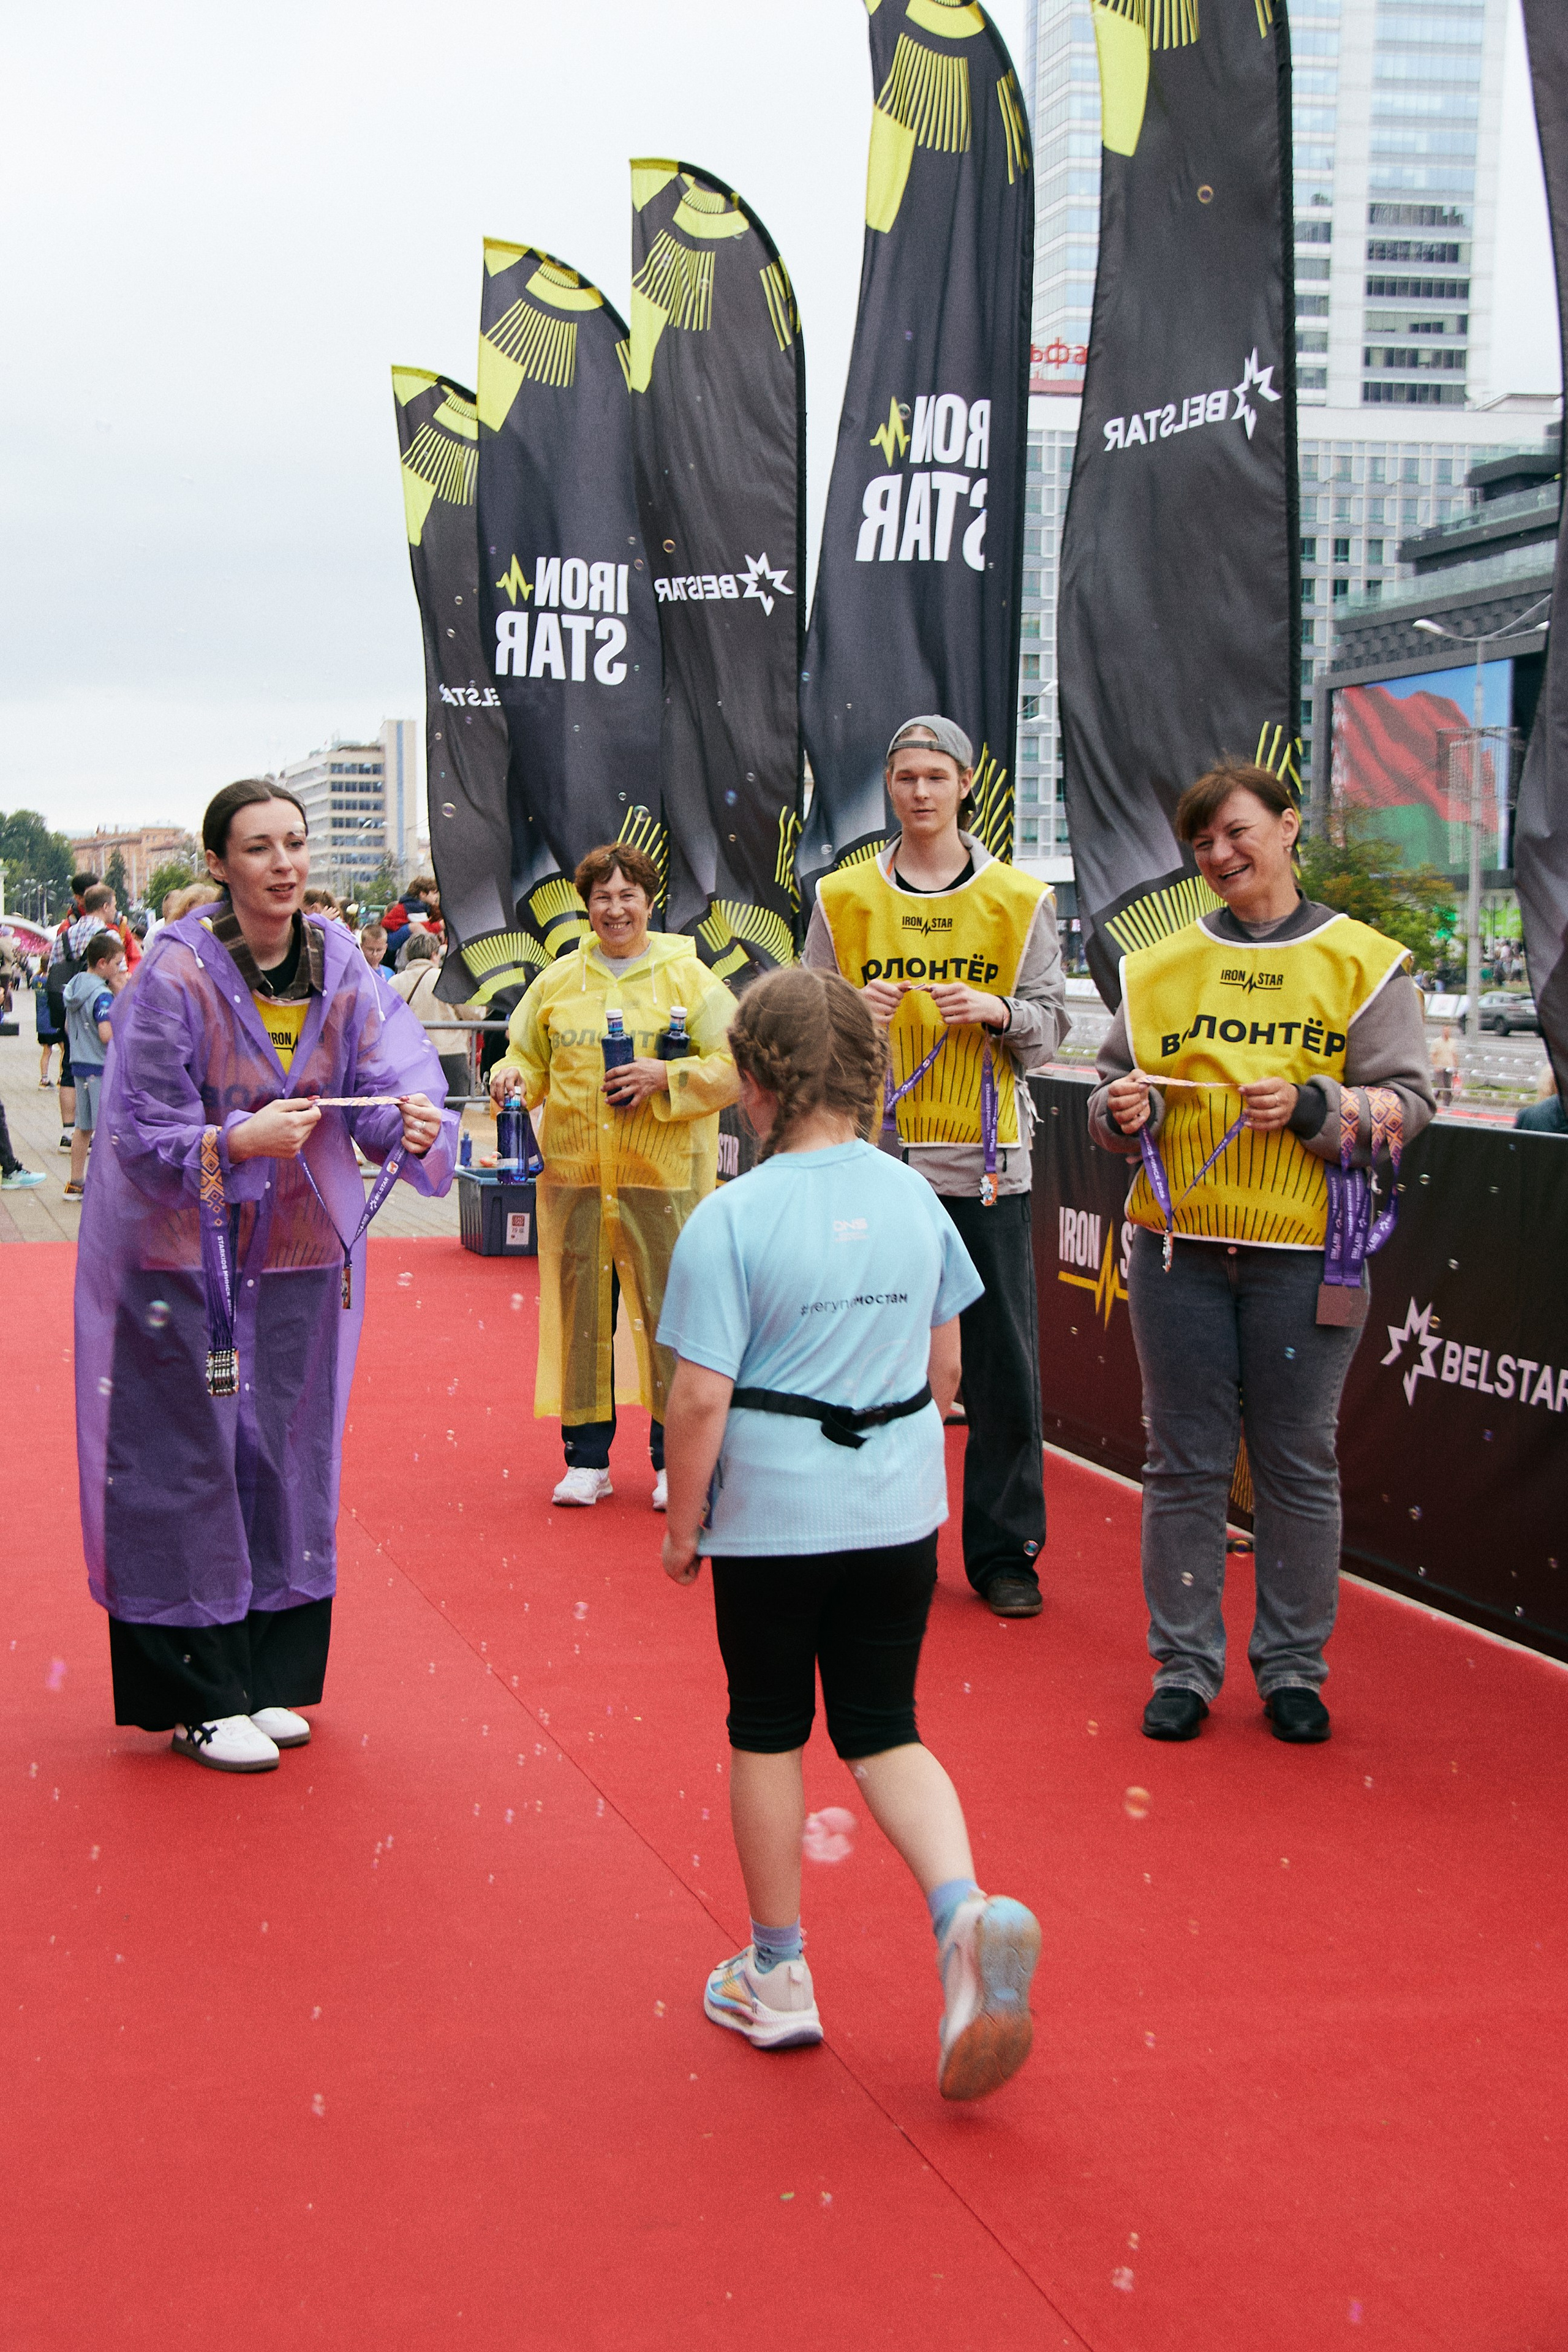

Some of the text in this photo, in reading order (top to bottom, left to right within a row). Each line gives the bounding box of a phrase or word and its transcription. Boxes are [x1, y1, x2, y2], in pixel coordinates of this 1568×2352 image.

[902, 916, 952, 929] IRON STAR
[861, 953, 999, 986] ОЛОНТЁР
[1220, 968, 1283, 987] IRON STAR
[268, 1032, 292, 1045] RON
[1161, 1014, 1346, 1058] ВЛОНТЁР
[717, 1133, 739, 1176] STAR
[374, 1177, 390, 1200] BELSTAR
[1156, 1181, 1166, 1199] 2026
[1059, 1206, 1101, 1270] IRON
[217, 1235, 227, 1270] STARKIDS
[222, 1270, 231, 1296] МИНСК
[1441, 1340, 1568, 1412] BELSTAR
